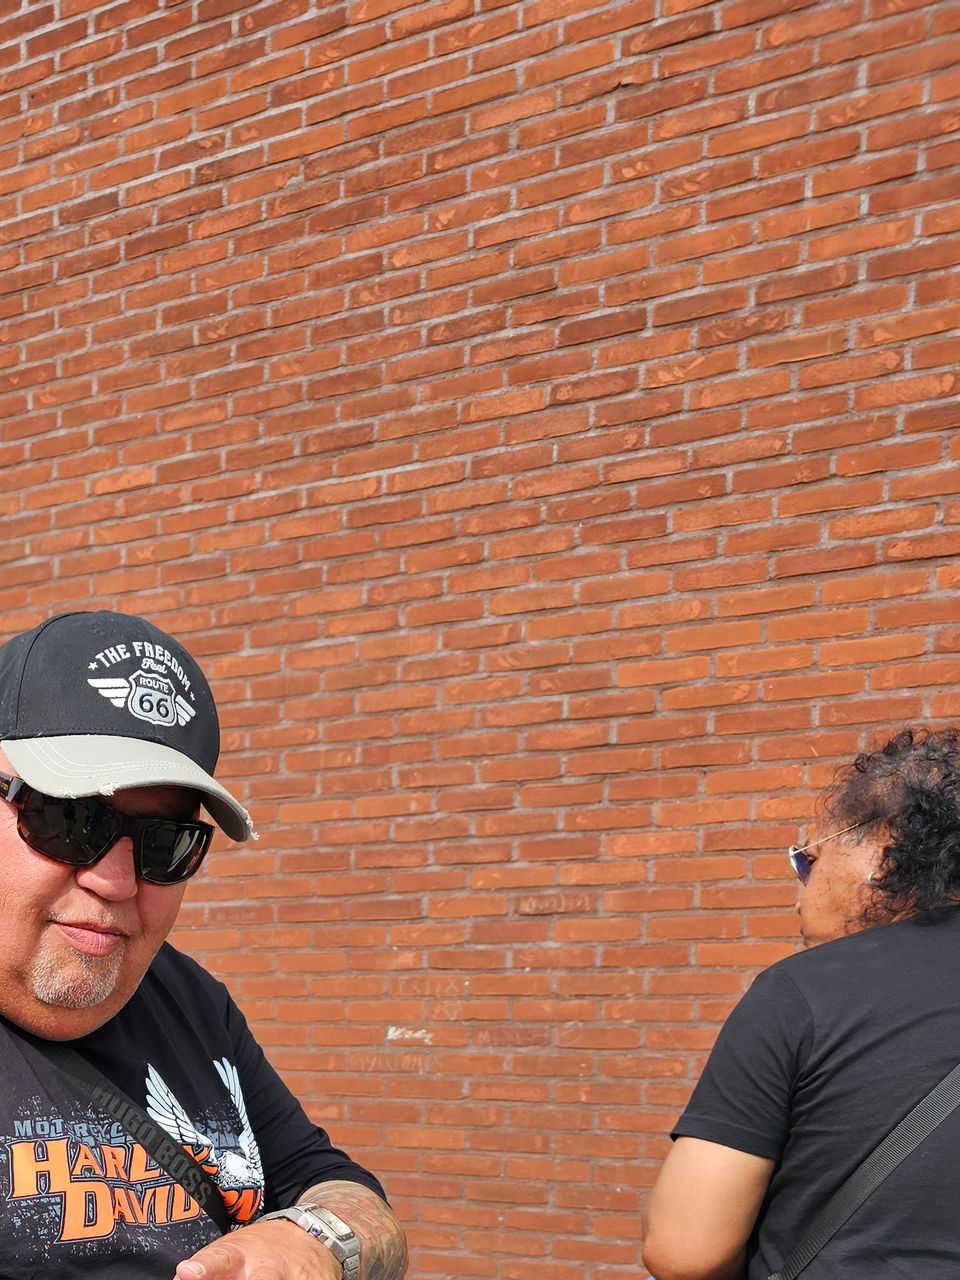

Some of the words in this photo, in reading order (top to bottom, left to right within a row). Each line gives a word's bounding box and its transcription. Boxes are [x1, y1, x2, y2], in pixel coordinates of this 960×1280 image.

[95, 643, 131, 668] THE
[132, 641, 191, 692] FREEDOM
[139, 676, 169, 693] ROUTE
[139, 692, 170, 718] 66
[154, 1138, 211, 1206] BOSS
